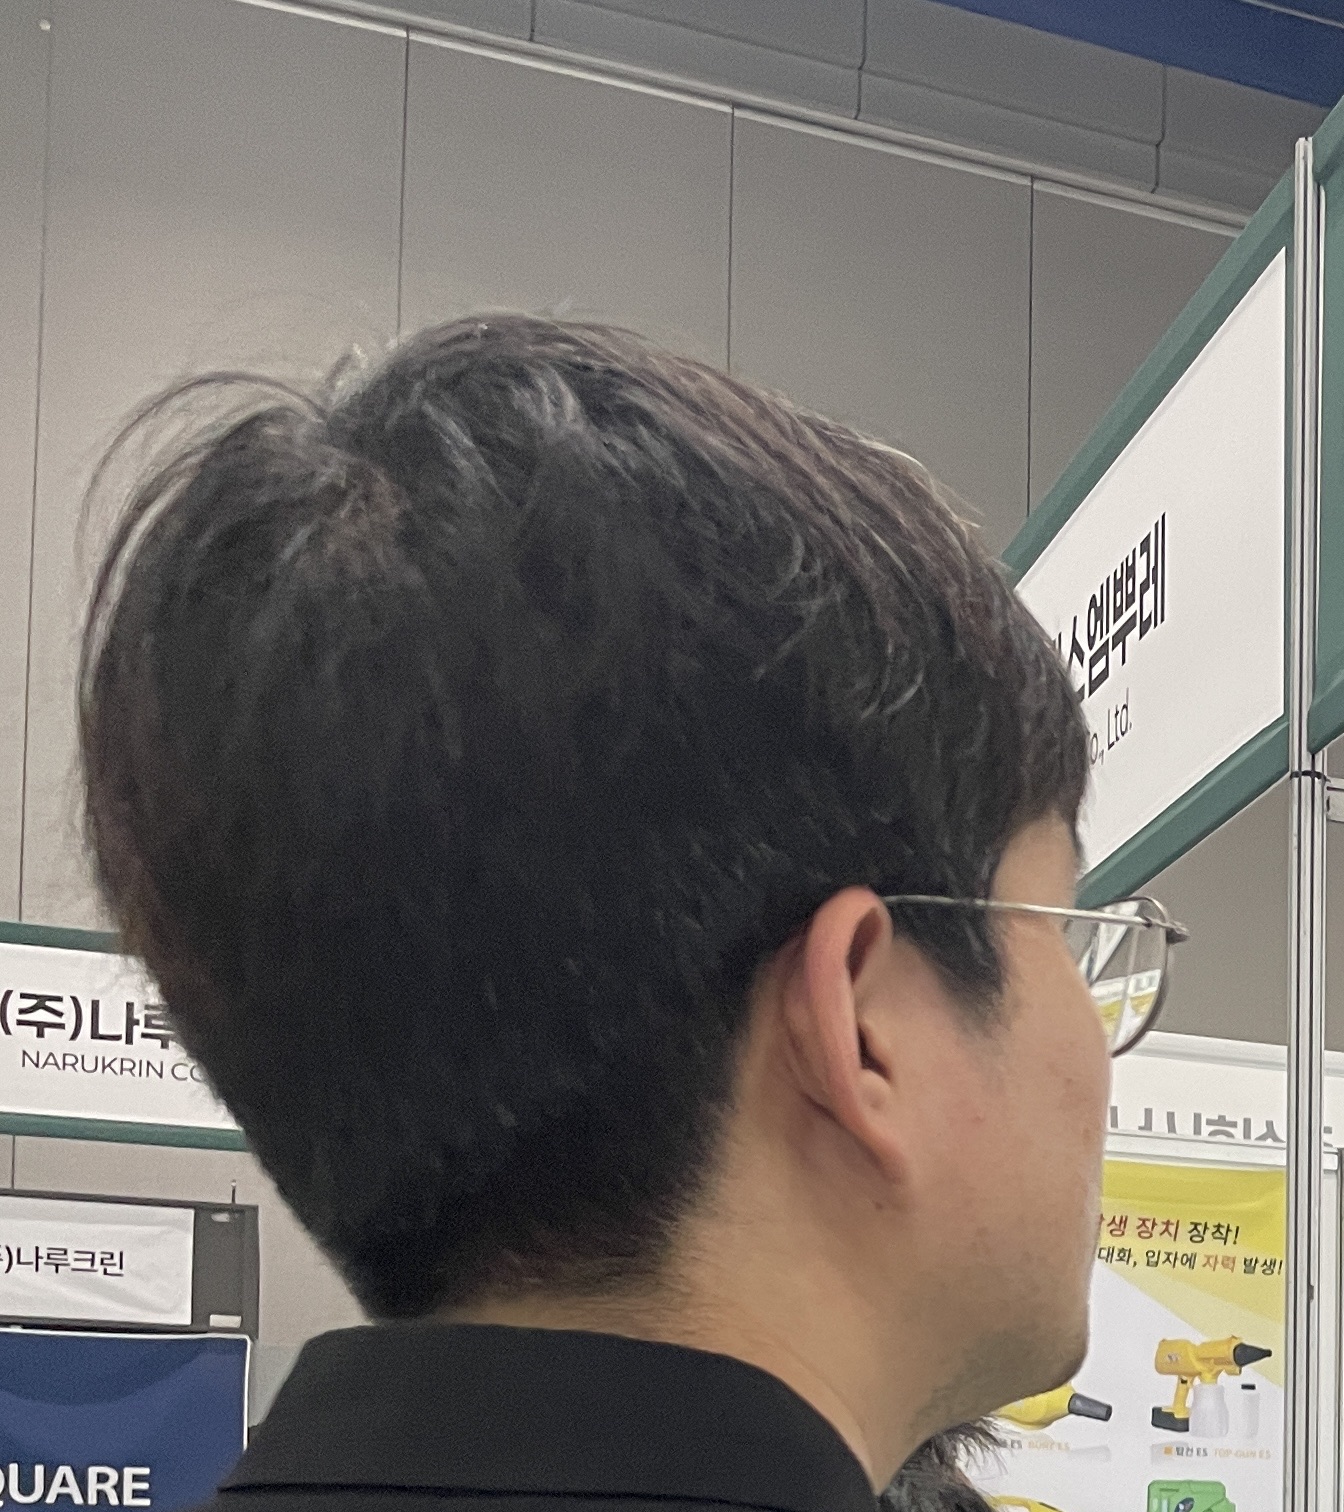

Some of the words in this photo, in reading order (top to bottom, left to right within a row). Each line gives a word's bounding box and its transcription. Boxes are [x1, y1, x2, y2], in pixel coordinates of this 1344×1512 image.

[1057, 512, 1166, 703] 스엠뿌레
[1107, 687, 1132, 751] Ltd.
[21, 1049, 164, 1079] NARUKRIN
[1100, 1213, 1128, 1237] 생
[1136, 1217, 1180, 1241] 장치
[1188, 1221, 1240, 1246] 장착!
[0, 1245, 125, 1277] )나루크린
[1145, 1249, 1197, 1270] 입자에
[1202, 1254, 1236, 1273] 자력
[1243, 1256, 1283, 1276] 발생!
